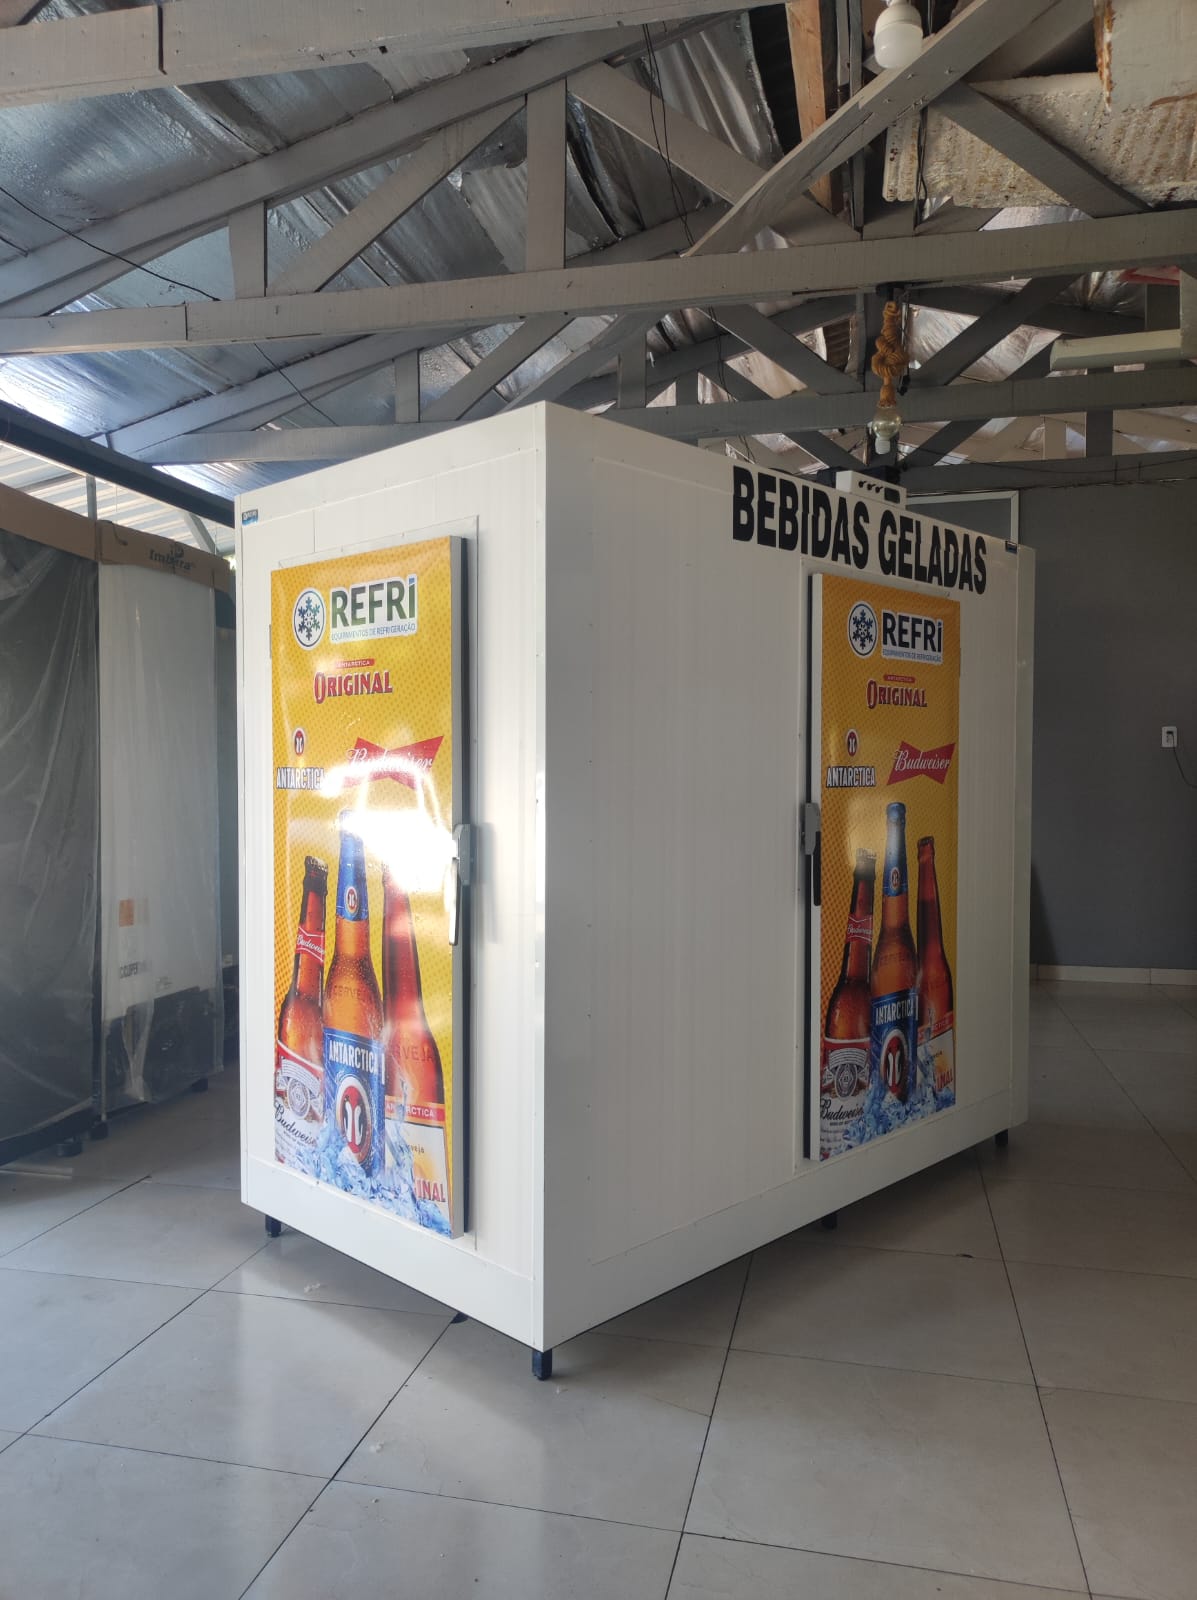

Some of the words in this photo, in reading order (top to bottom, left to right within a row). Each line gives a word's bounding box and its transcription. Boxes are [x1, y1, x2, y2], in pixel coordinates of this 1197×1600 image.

[733, 465, 869, 570] BEBIDAS
[879, 509, 987, 595] GELADAS
[314, 670, 393, 704] ORIGINAL
[866, 679, 928, 709] ORIGINAL
[894, 748, 951, 772] Budweiser
[826, 766, 877, 788] ANTARCTICA
[875, 998, 914, 1026] ANTARCTICA
[328, 1039, 378, 1074] ANTARCTICA
